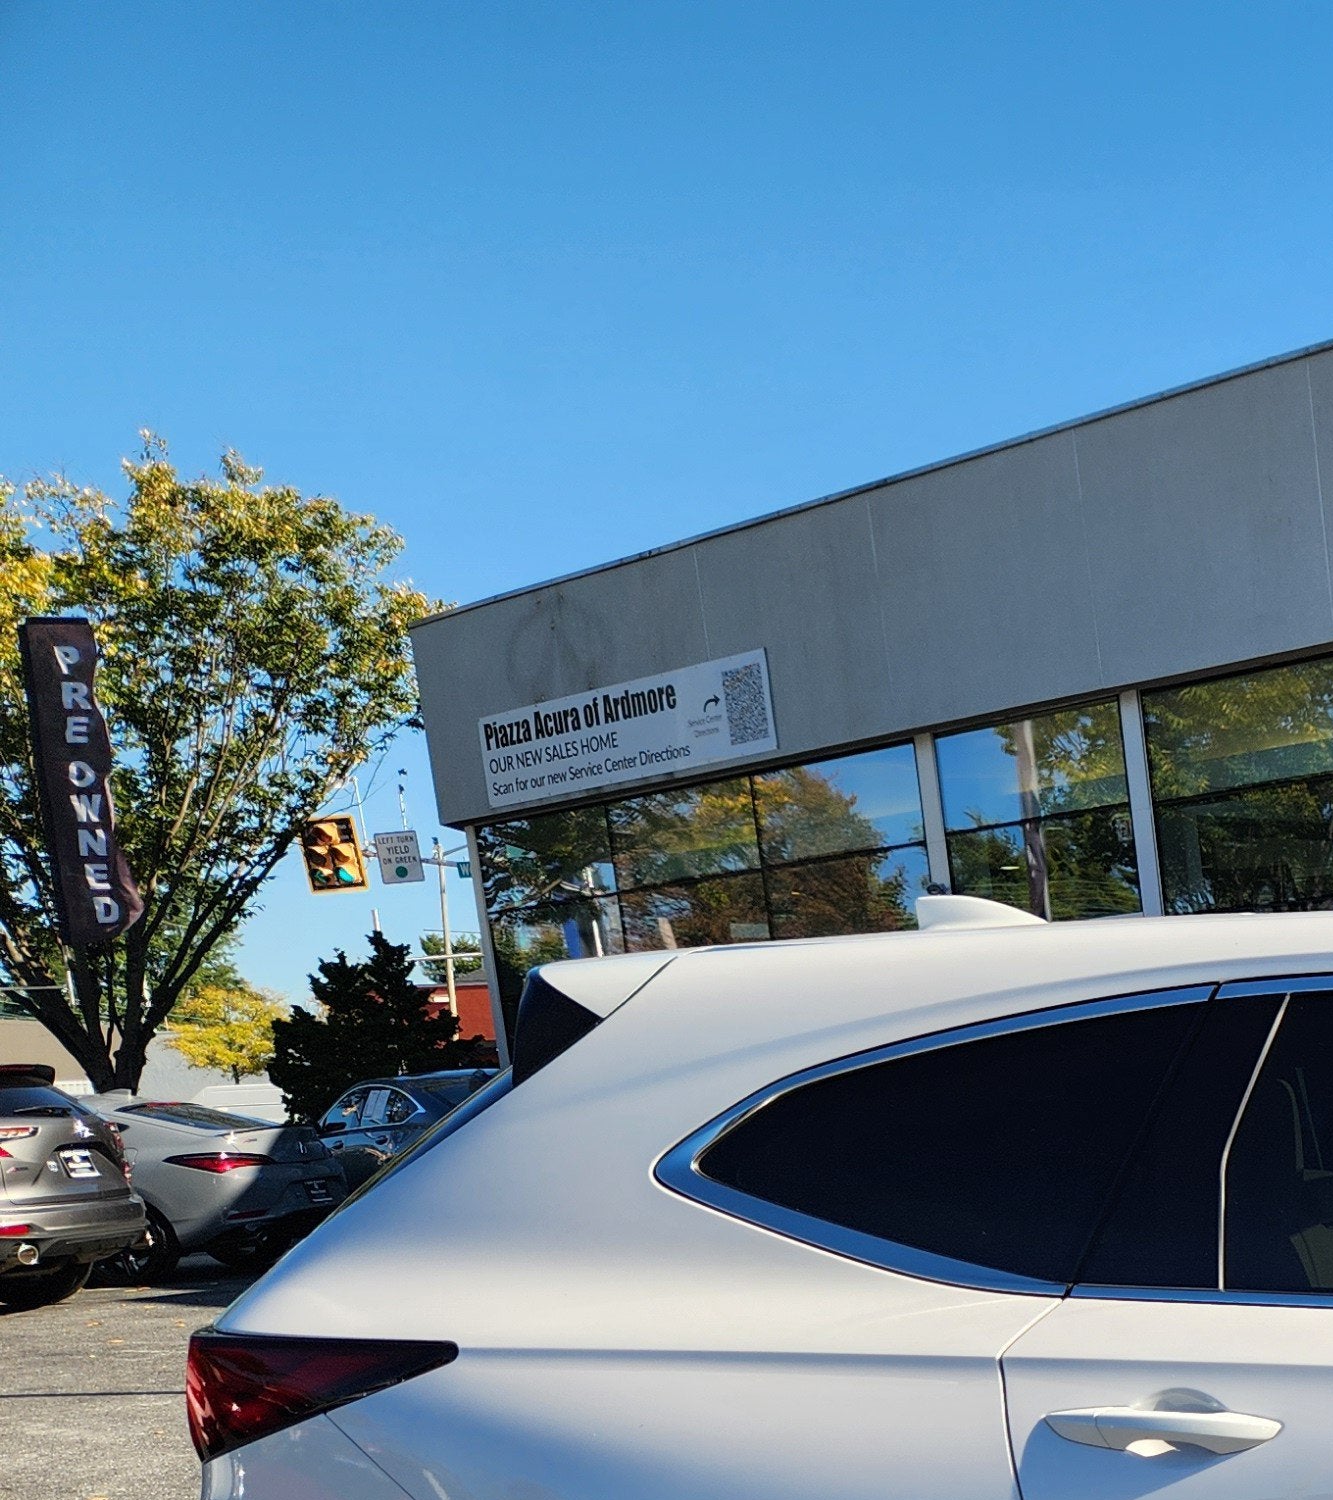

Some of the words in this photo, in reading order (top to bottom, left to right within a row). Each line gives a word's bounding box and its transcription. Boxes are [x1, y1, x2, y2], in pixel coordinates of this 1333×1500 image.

[53, 645, 93, 744] PRE
[484, 719, 532, 751] Piazza
[533, 707, 581, 740] Acura
[583, 697, 601, 728] of
[602, 684, 677, 724] Ardmore
[489, 755, 515, 774] OUR
[515, 748, 542, 769] NEW
[545, 741, 579, 763] SALES
[580, 732, 619, 756] HOME
[492, 782, 514, 796] Scan
[515, 778, 529, 792] for
[531, 775, 546, 789] our
[547, 772, 567, 785] new
[568, 762, 602, 780] Service
[604, 755, 637, 773] Center
[639, 744, 691, 766] Directions
[68, 760, 120, 924] OWNED
[377, 836, 394, 845] LEFT
[396, 835, 414, 843] TURN
[386, 846, 410, 855] YIELD
[396, 856, 417, 864] GREEN
